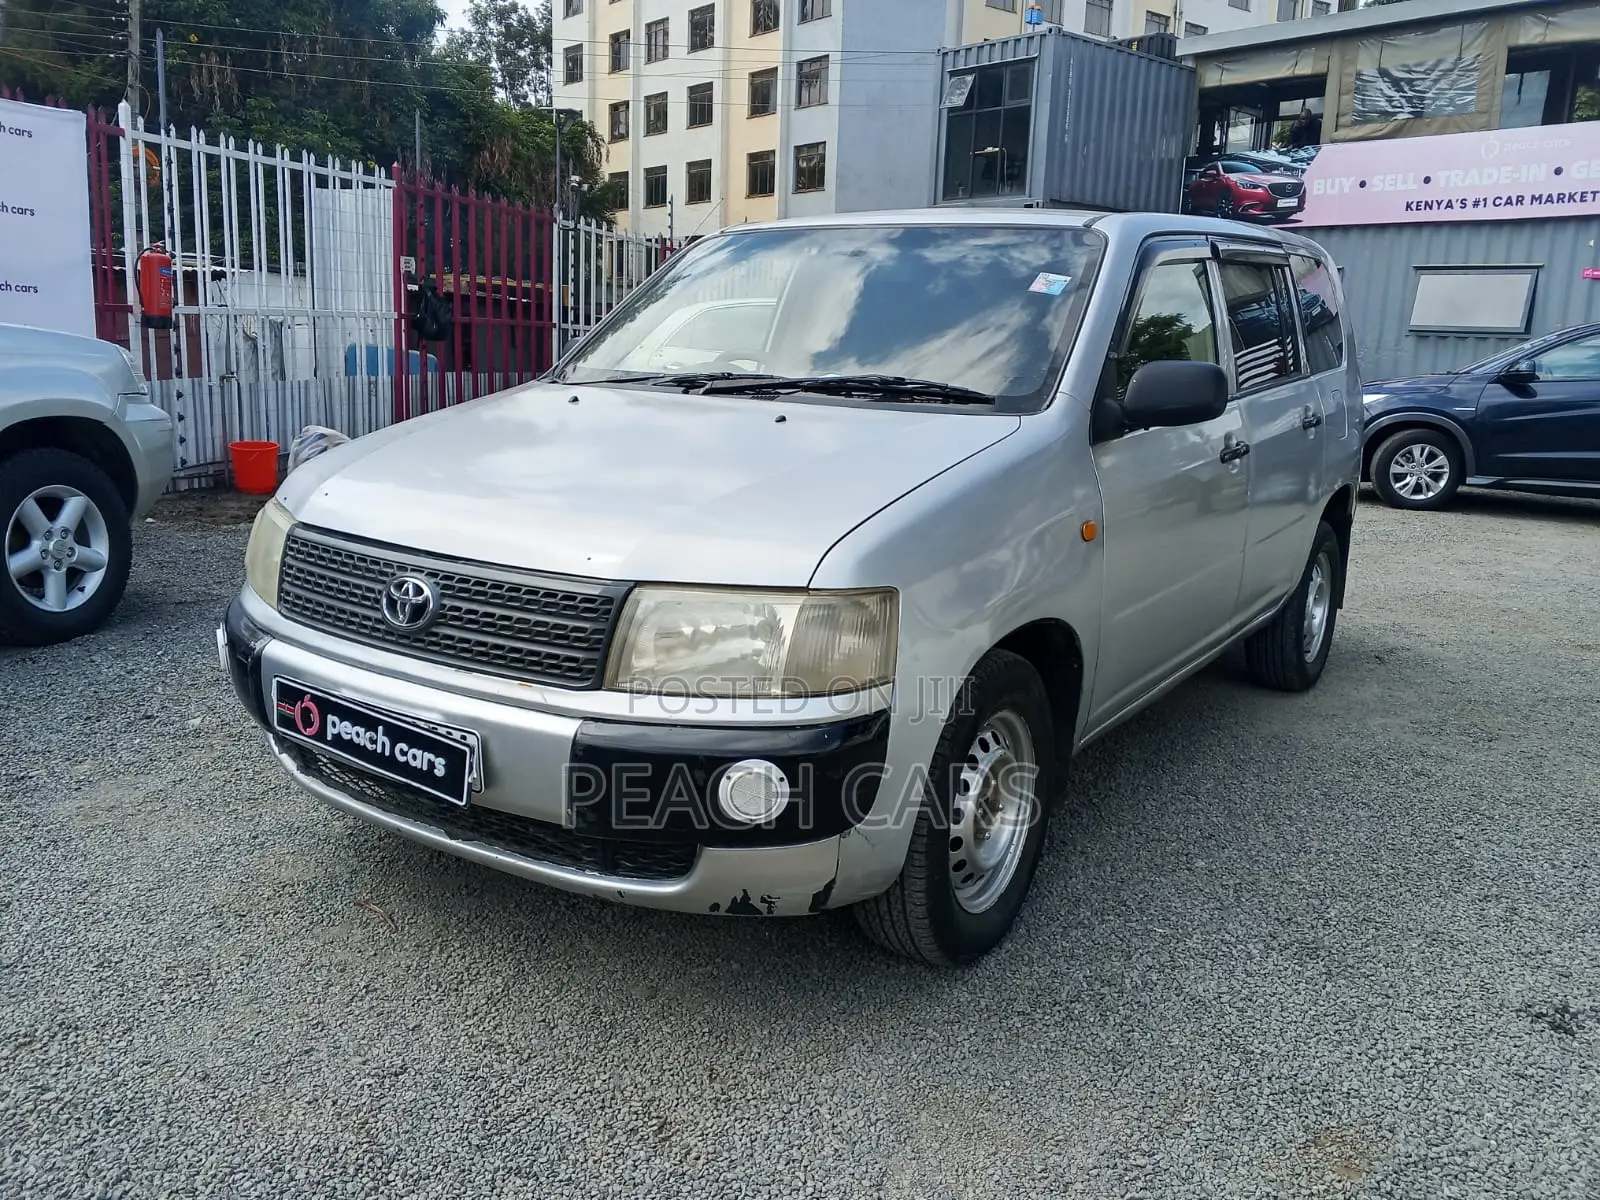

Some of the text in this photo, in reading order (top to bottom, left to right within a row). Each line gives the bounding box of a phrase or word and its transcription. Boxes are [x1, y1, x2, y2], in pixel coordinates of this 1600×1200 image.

[8, 126, 33, 138] cars
[1313, 177, 1355, 195] BUY
[1371, 173, 1418, 192] SELL
[1437, 162, 1547, 188] TRADE-IN
[1405, 191, 1600, 212] KENYA'S #1 CAR MARKET
[10, 206, 35, 217] cars
[14, 284, 38, 294] cars
[326, 713, 446, 777] peach cars
